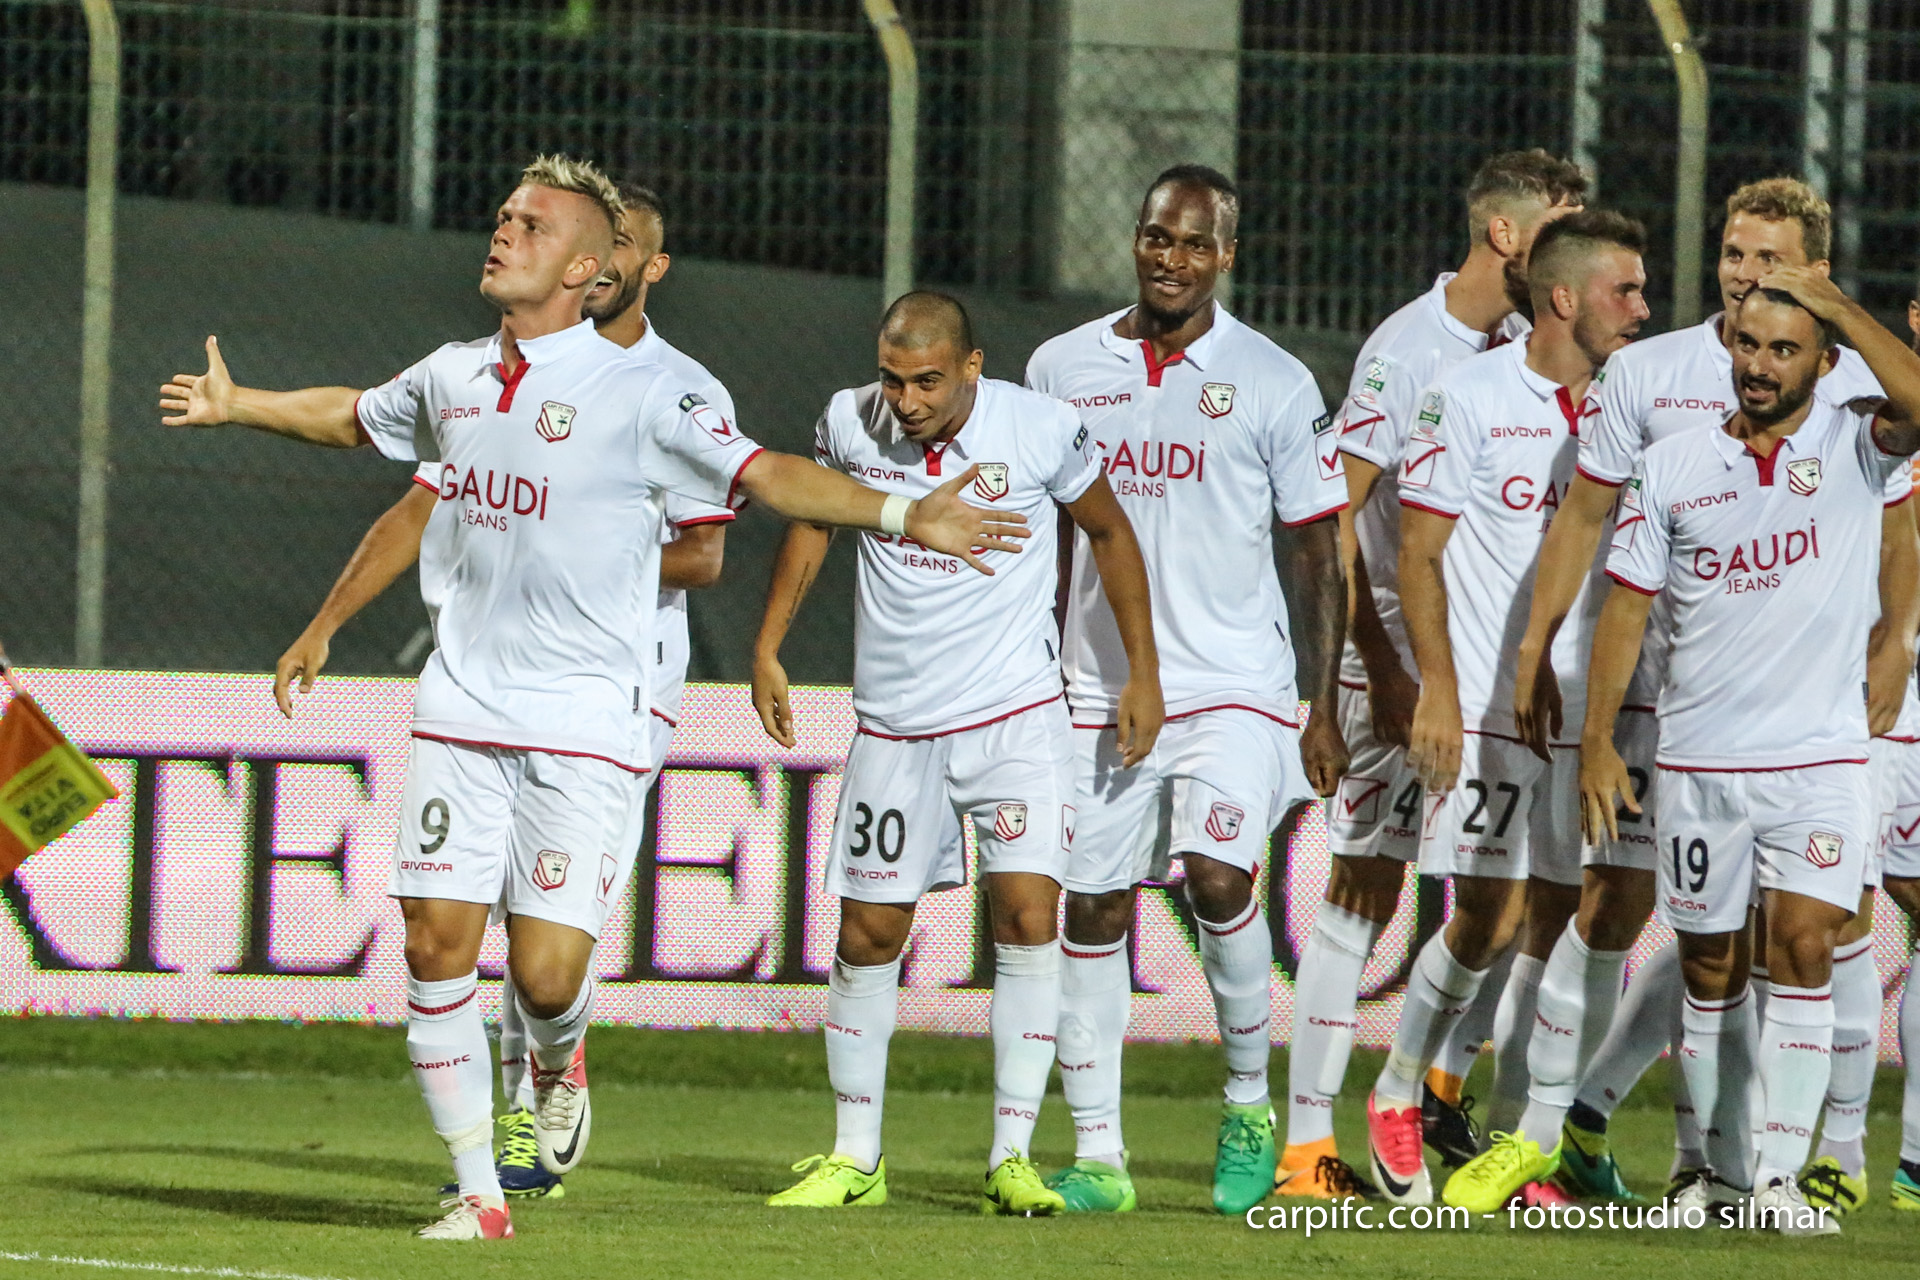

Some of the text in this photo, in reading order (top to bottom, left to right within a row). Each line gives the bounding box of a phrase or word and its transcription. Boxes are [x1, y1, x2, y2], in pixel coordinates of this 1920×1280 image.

[1653, 397, 1726, 411] GIVOVA
[440, 407, 480, 420] GIVOVA
[1491, 426, 1551, 438] GIVOVA
[847, 461, 906, 482] GIVOVA
[1115, 480, 1165, 498] JEANS
[1671, 491, 1738, 514] GIVOVA
[462, 508, 508, 532] JEANS
[902, 553, 958, 574] JEANS
[1726, 573, 1781, 595] JEANS
[1463, 779, 1520, 838] 27
[419, 797, 450, 855] 9
[850, 802, 906, 863] 30
[1457, 844, 1508, 857] GIVOVA
[401, 861, 453, 873] GIVOVA
[847, 866, 898, 880] GIVOVA
[1672, 835, 1709, 893] 19
[1669, 896, 1707, 912] GIVOVA
[844, 1028, 863, 1037] FC
[452, 1054, 472, 1066] FC
